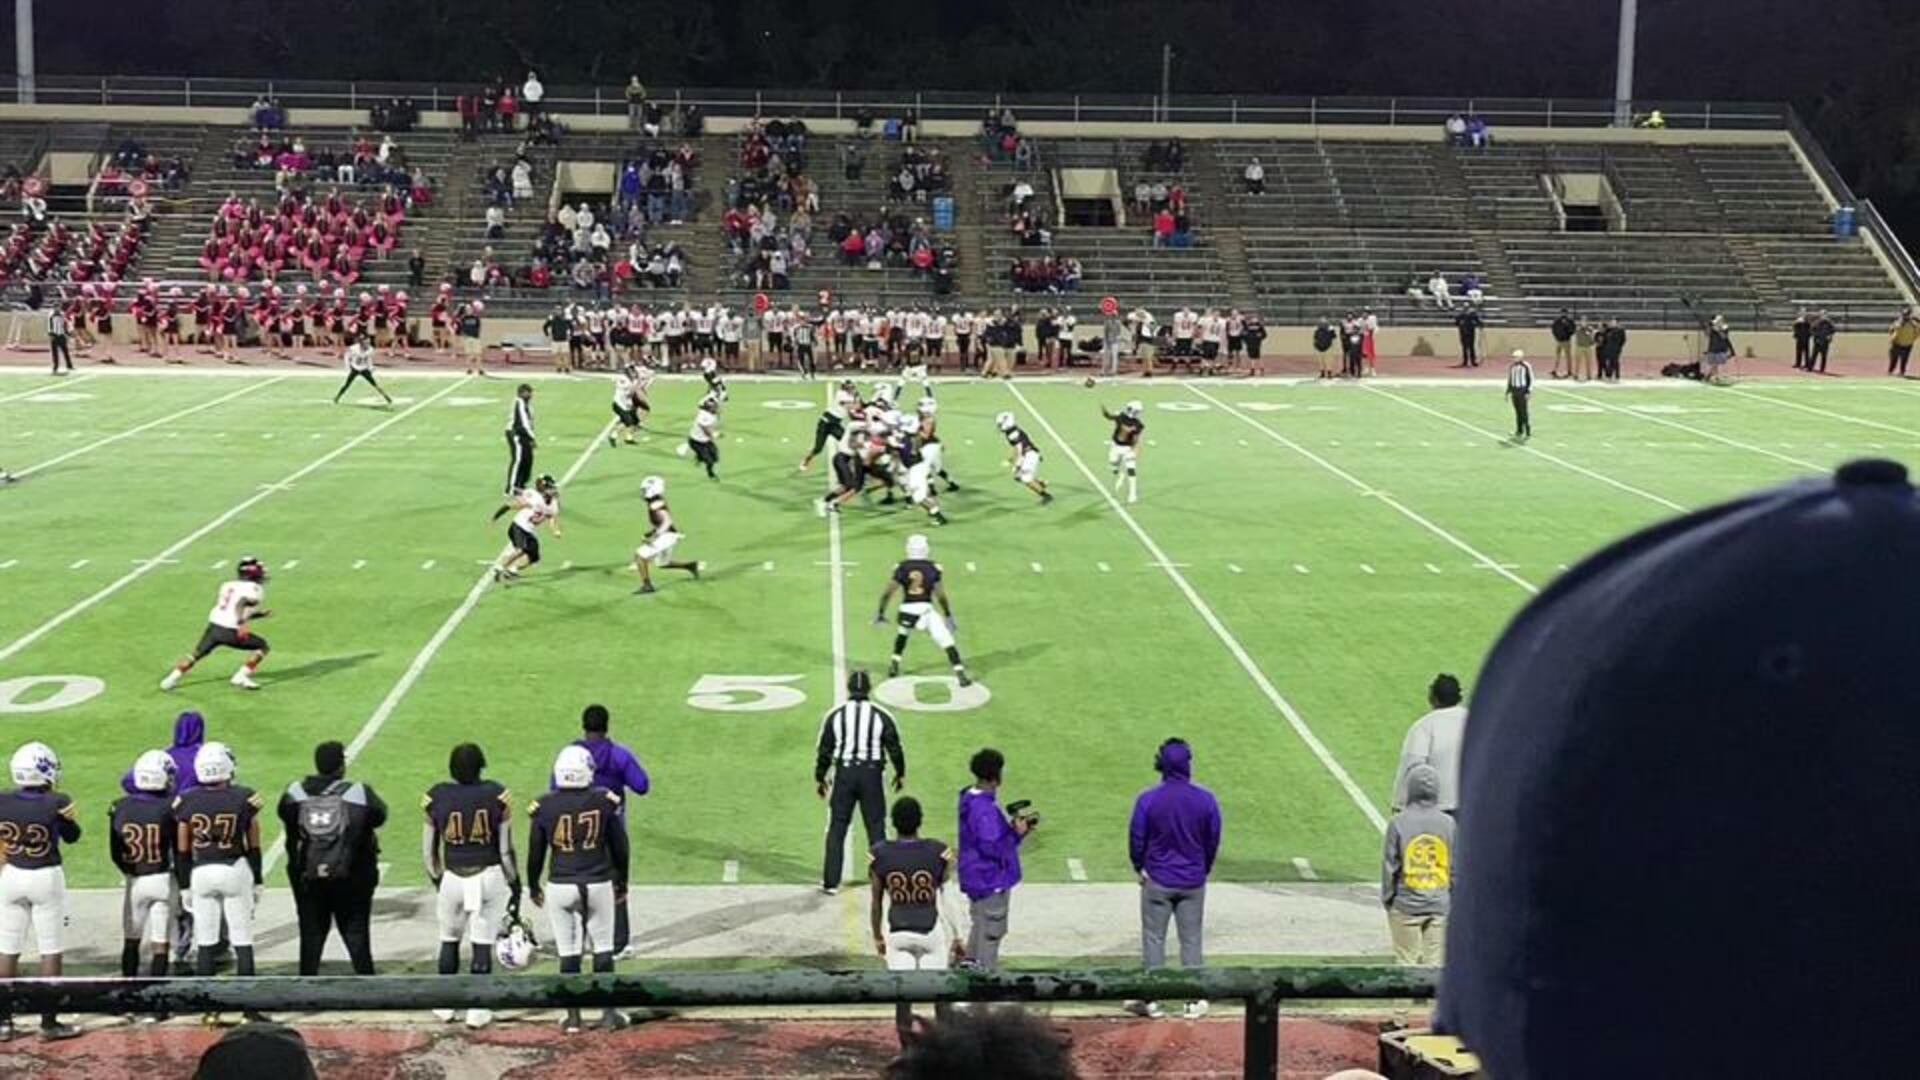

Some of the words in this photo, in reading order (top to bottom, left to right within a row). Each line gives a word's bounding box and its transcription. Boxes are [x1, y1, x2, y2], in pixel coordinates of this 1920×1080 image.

[908, 570, 924, 595] 2
[122, 823, 162, 864] 31
[191, 813, 238, 849] 37
[445, 809, 491, 845] 44
[553, 810, 600, 851] 47
[887, 870, 934, 904] 88
